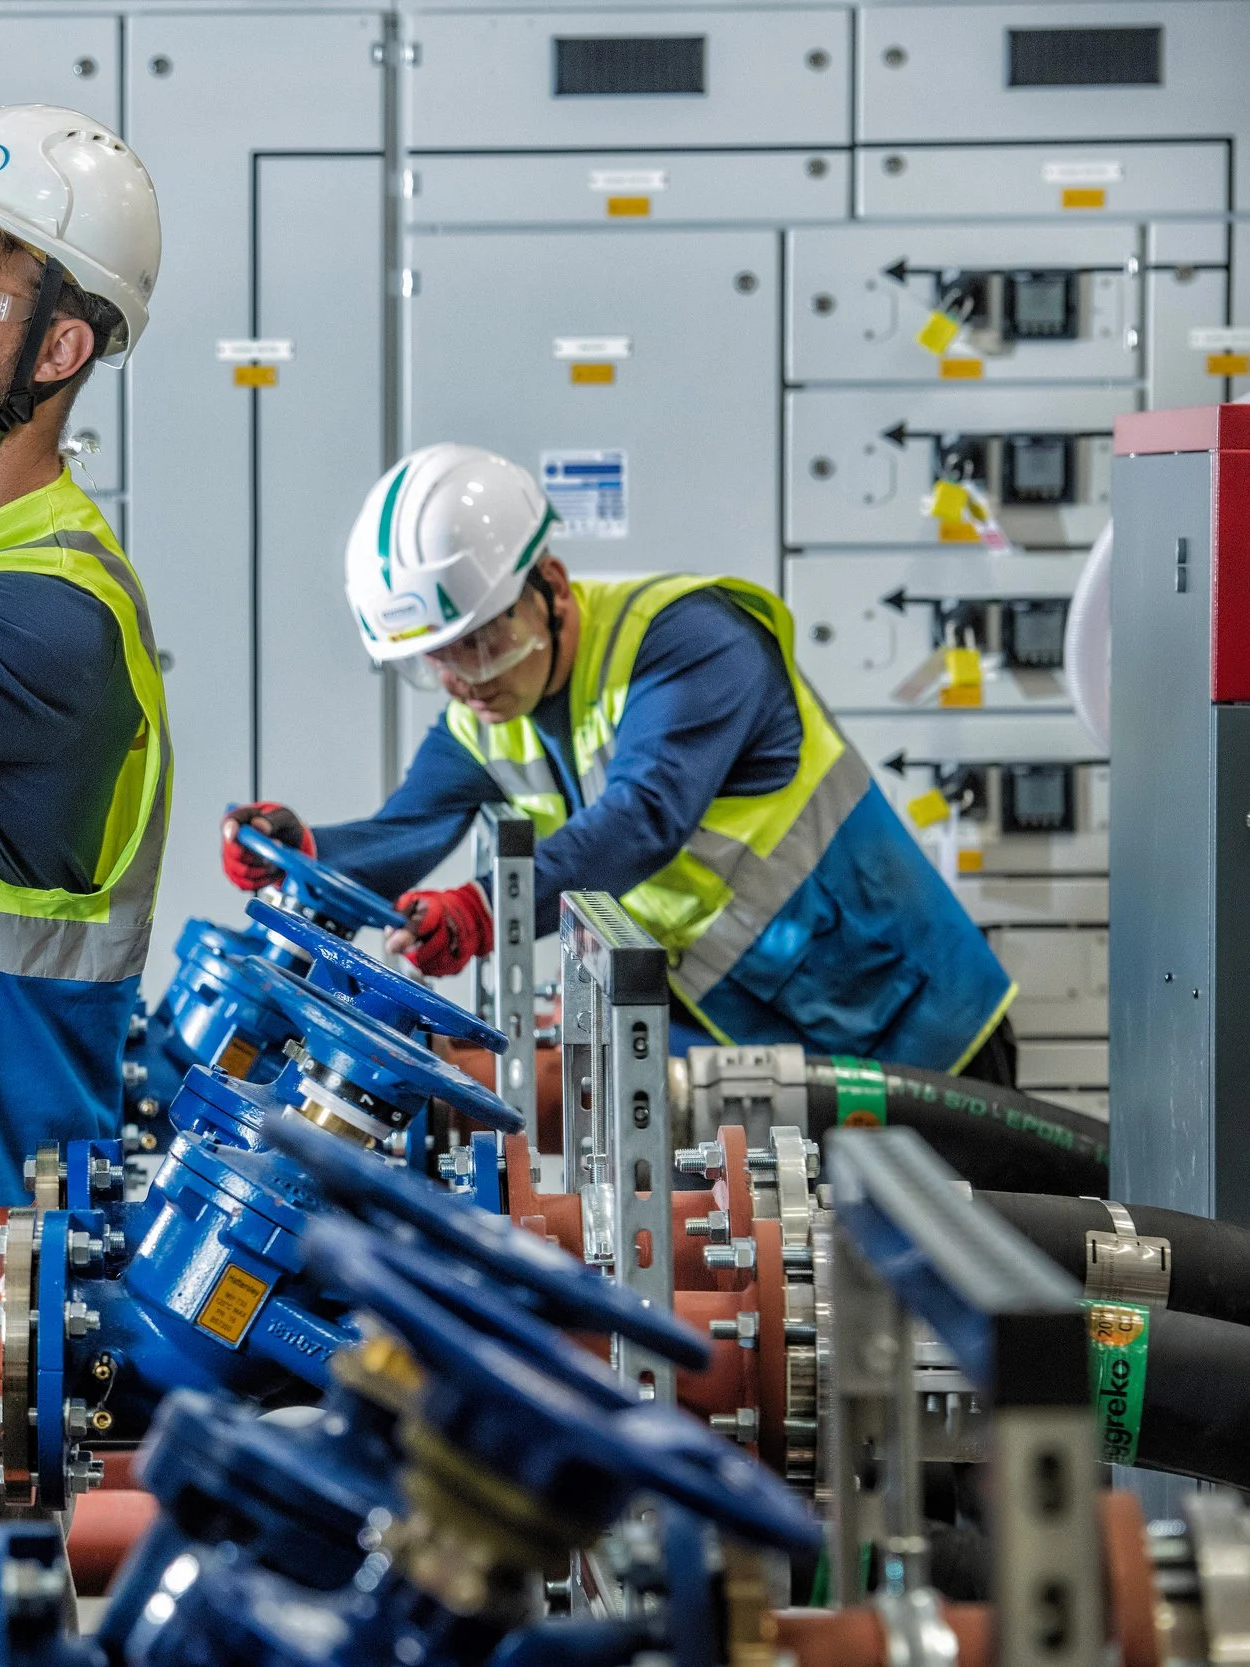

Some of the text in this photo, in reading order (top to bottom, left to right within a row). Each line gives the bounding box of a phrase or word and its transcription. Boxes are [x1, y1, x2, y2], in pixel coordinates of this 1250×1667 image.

[360, 1094, 374, 1106] 7
[1005, 1109, 1075, 1149] EPDM
[229, 1275, 260, 1298] Hattersley
[1100, 1359, 1133, 1462] ggreko
